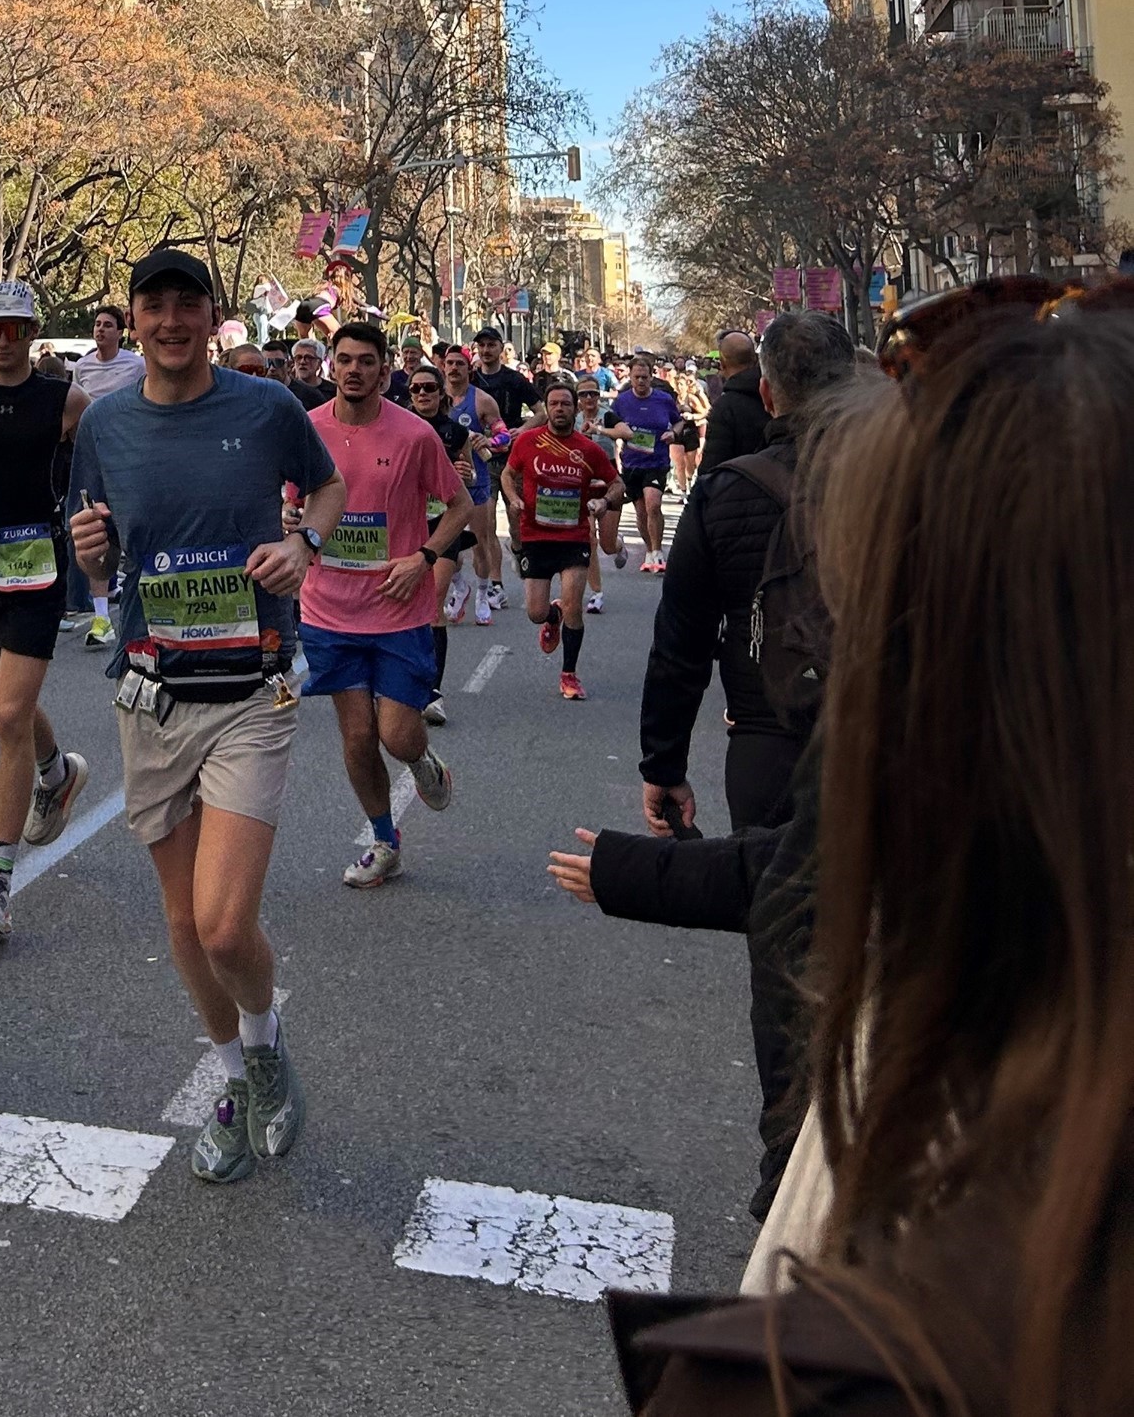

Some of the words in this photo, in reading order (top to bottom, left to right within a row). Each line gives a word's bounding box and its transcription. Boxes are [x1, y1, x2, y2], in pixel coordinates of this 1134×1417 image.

[341, 513, 374, 523] ZURICH
[3, 527, 38, 540] ZURICH
[176, 549, 228, 566] ZURICH
[140, 580, 181, 599] TOM
[185, 572, 251, 598] RANBY
[185, 601, 218, 615] 7294
[181, 627, 215, 639] HOKA
